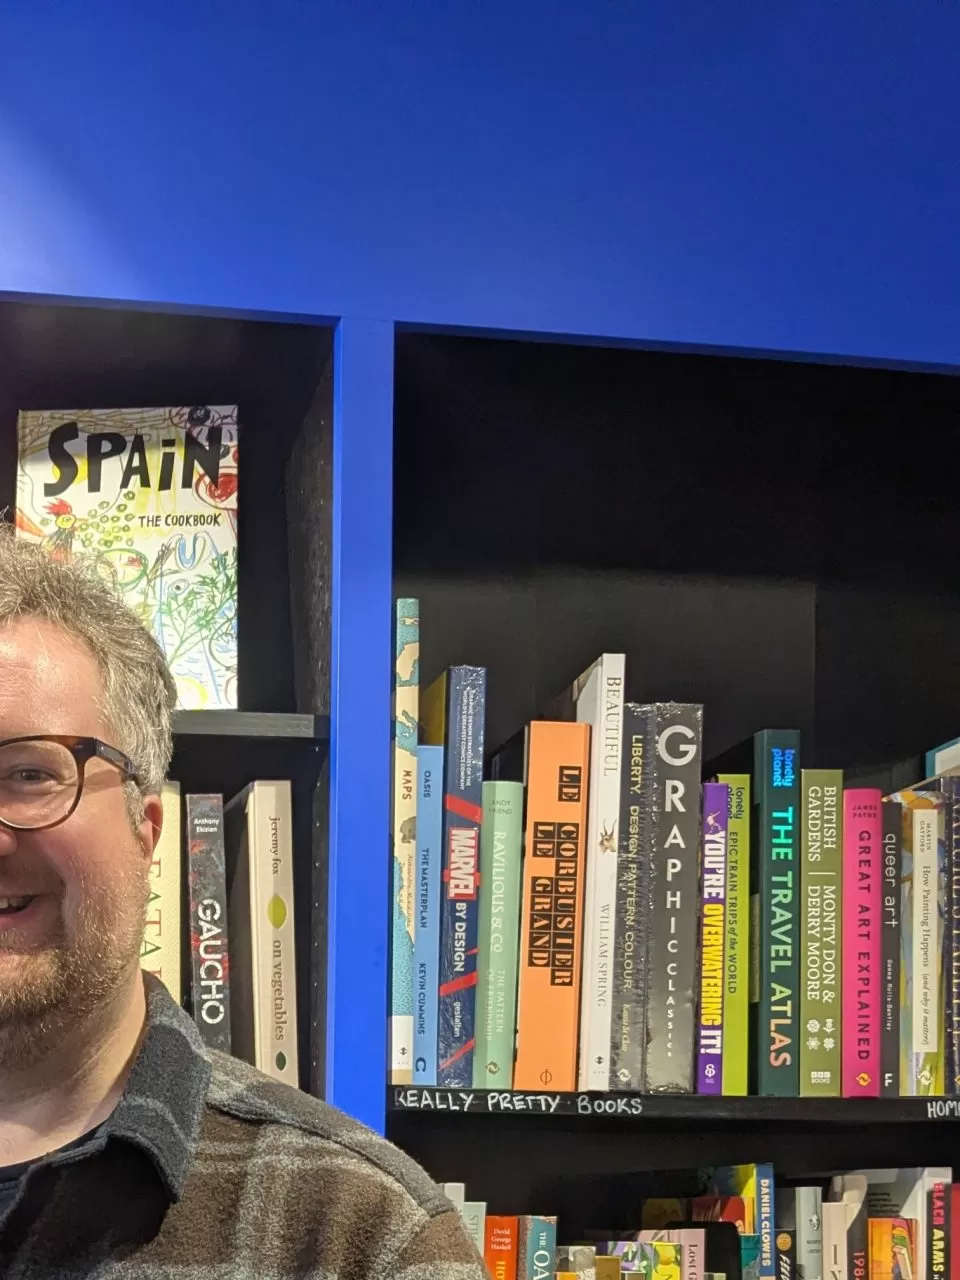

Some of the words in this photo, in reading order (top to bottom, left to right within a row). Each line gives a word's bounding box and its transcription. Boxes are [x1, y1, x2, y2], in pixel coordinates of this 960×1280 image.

[43, 421, 221, 497] SPAiN
[139, 514, 160, 527] THE
[165, 512, 221, 527] COOKBOOK
[424, 770, 432, 798] OASIS
[558, 766, 581, 803] LE
[771, 749, 782, 787] planet
[784, 749, 795, 787] lonely
[194, 818, 219, 826] Anthony
[269, 816, 281, 858] jeremy
[533, 822, 555, 858] LE
[658, 725, 696, 954] GRAPHIC
[772, 807, 793, 860] THE
[809, 787, 821, 861] GARDENS
[825, 787, 836, 849] BRITISH
[272, 859, 280, 875] fox
[450, 829, 477, 898] MARVEL
[704, 831, 726, 898] YOU'RE
[859, 830, 871, 893] GREAT
[883, 834, 897, 887] queer
[420, 869, 428, 928] MASTERPLAN
[456, 903, 467, 922] BY
[528, 877, 551, 968] GRAND
[551, 822, 579, 986] CORBUSIER
[808, 886, 820, 934] DERRY
[824, 886, 836, 942] MONTY
[858, 905, 870, 940] ART
[884, 896, 898, 927] art
[455, 925, 467, 972] DESIGN
[770, 875, 792, 973] TRAVEL
[198, 899, 224, 1024] GAUCHO
[273, 940, 281, 959] on
[702, 903, 724, 1026] OVERWATERING
[807, 937, 819, 999] MOORE
[823, 947, 835, 982] DON
[272, 961, 287, 1041] vegetables
[418, 963, 426, 993] KEVIN
[823, 988, 832, 1002] &
[417, 995, 426, 1035] CUMMINS
[666, 960, 677, 1057] CLASSICS
[769, 984, 792, 1067] ATLAS
[857, 953, 870, 1060] EXPLAINED
[701, 1028, 721, 1053] IT!
[394, 1090, 475, 1111] REALLY
[487, 1093, 560, 1111] PRETTY
[576, 1095, 643, 1115] BOOKS
